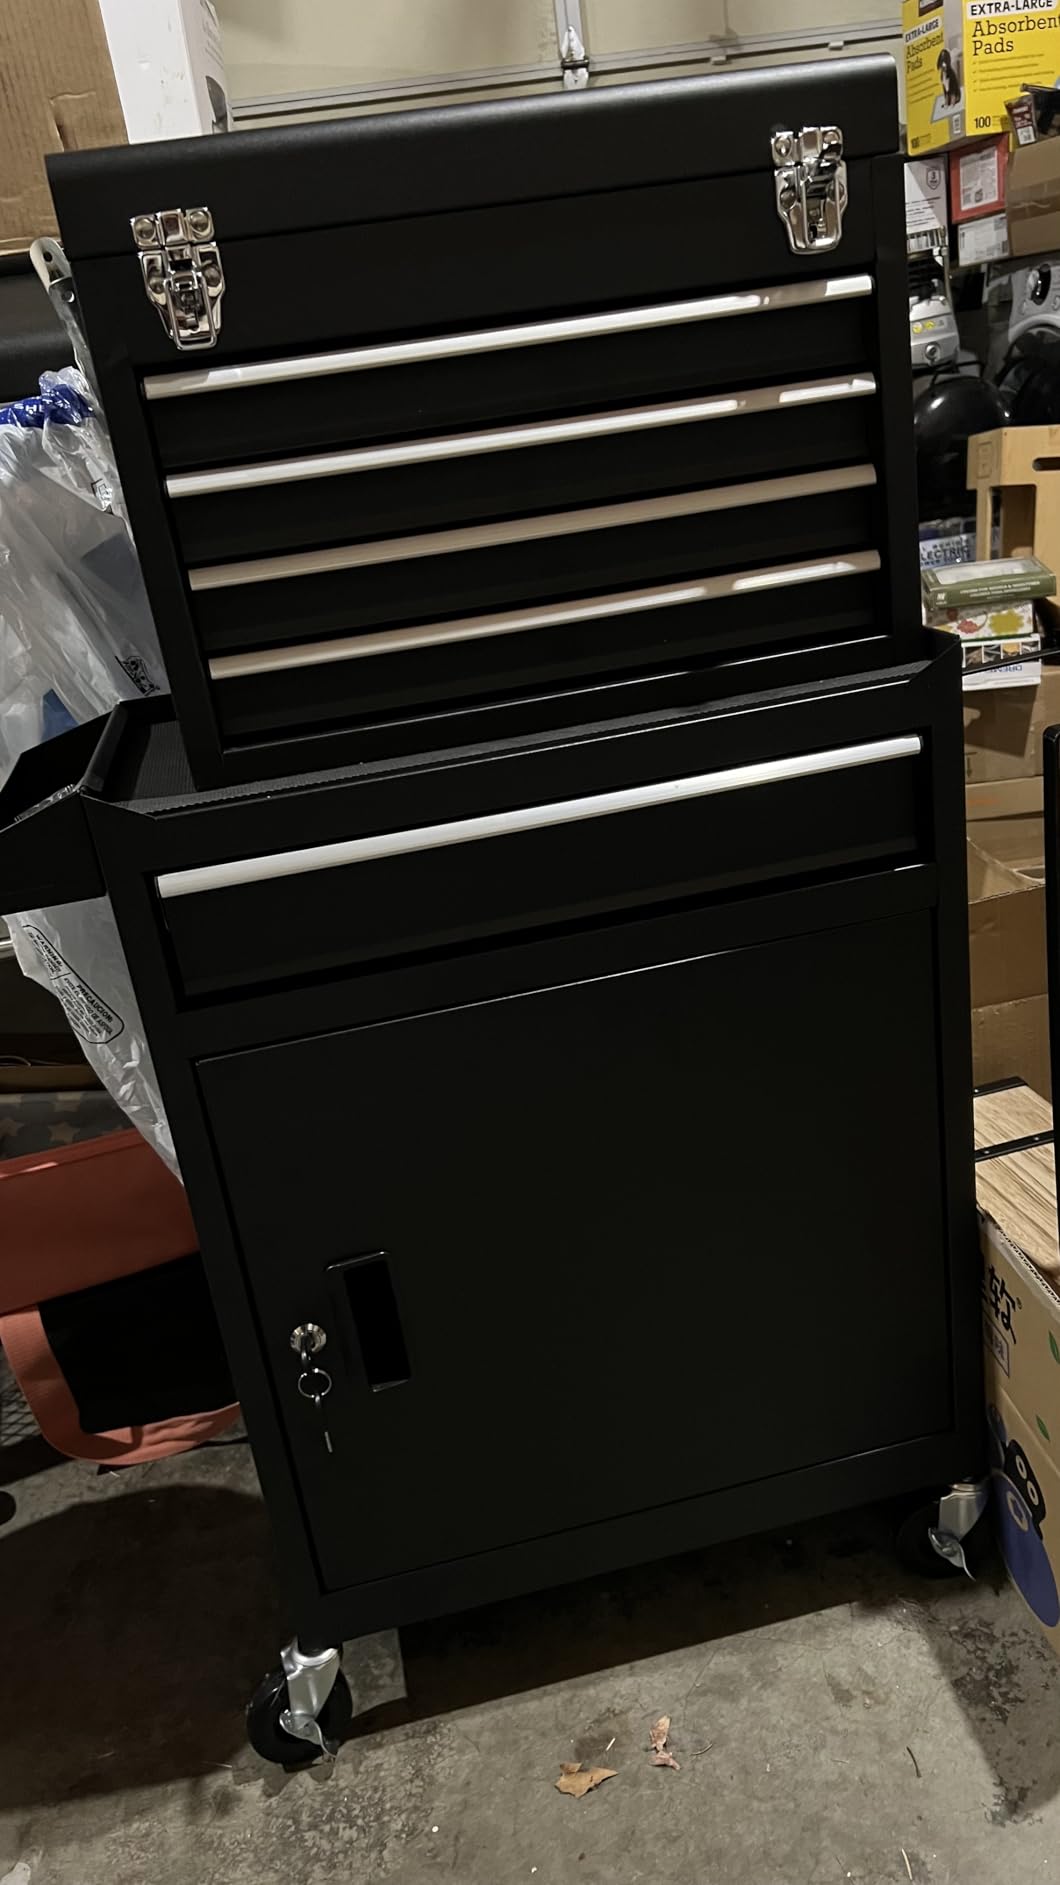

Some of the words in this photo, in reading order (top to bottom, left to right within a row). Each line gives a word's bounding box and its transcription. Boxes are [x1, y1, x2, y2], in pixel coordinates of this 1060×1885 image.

[971, 0, 1053, 16] EXTRA-LARGE
[905, 18, 939, 43] EXTRA-LARGE
[906, 31, 944, 59] Absorbent
[972, 37, 1014, 56] Pads
[906, 56, 923, 74] Pads
[974, 116, 991, 129] 100
